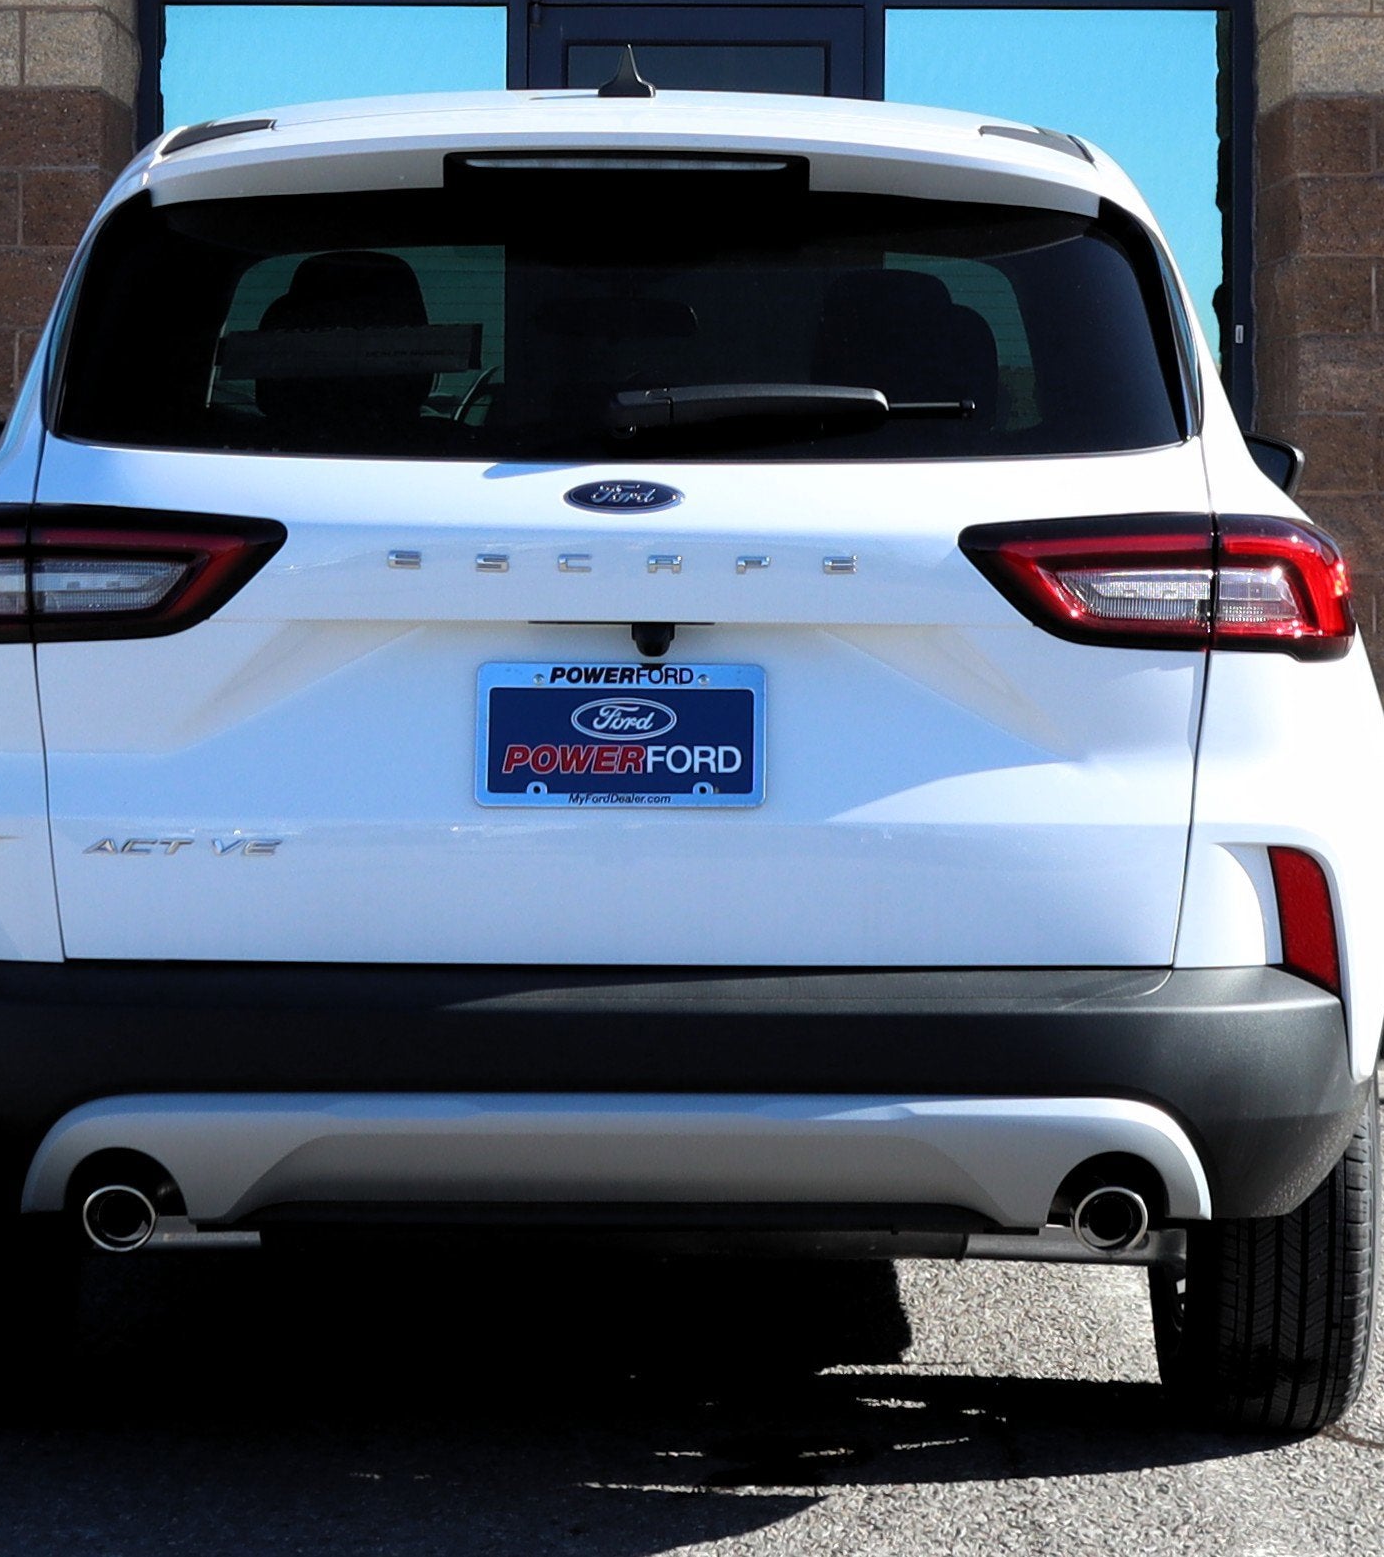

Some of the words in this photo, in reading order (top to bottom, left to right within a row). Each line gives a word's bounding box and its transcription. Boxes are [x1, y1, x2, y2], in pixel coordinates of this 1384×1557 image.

[591, 484, 657, 504] Ford
[387, 549, 859, 575] ESCAPE
[549, 665, 694, 685] POWERFORD
[592, 706, 654, 732] Ford
[502, 745, 742, 775] POWERFORD
[568, 793, 671, 805] MyFordDealer.com
